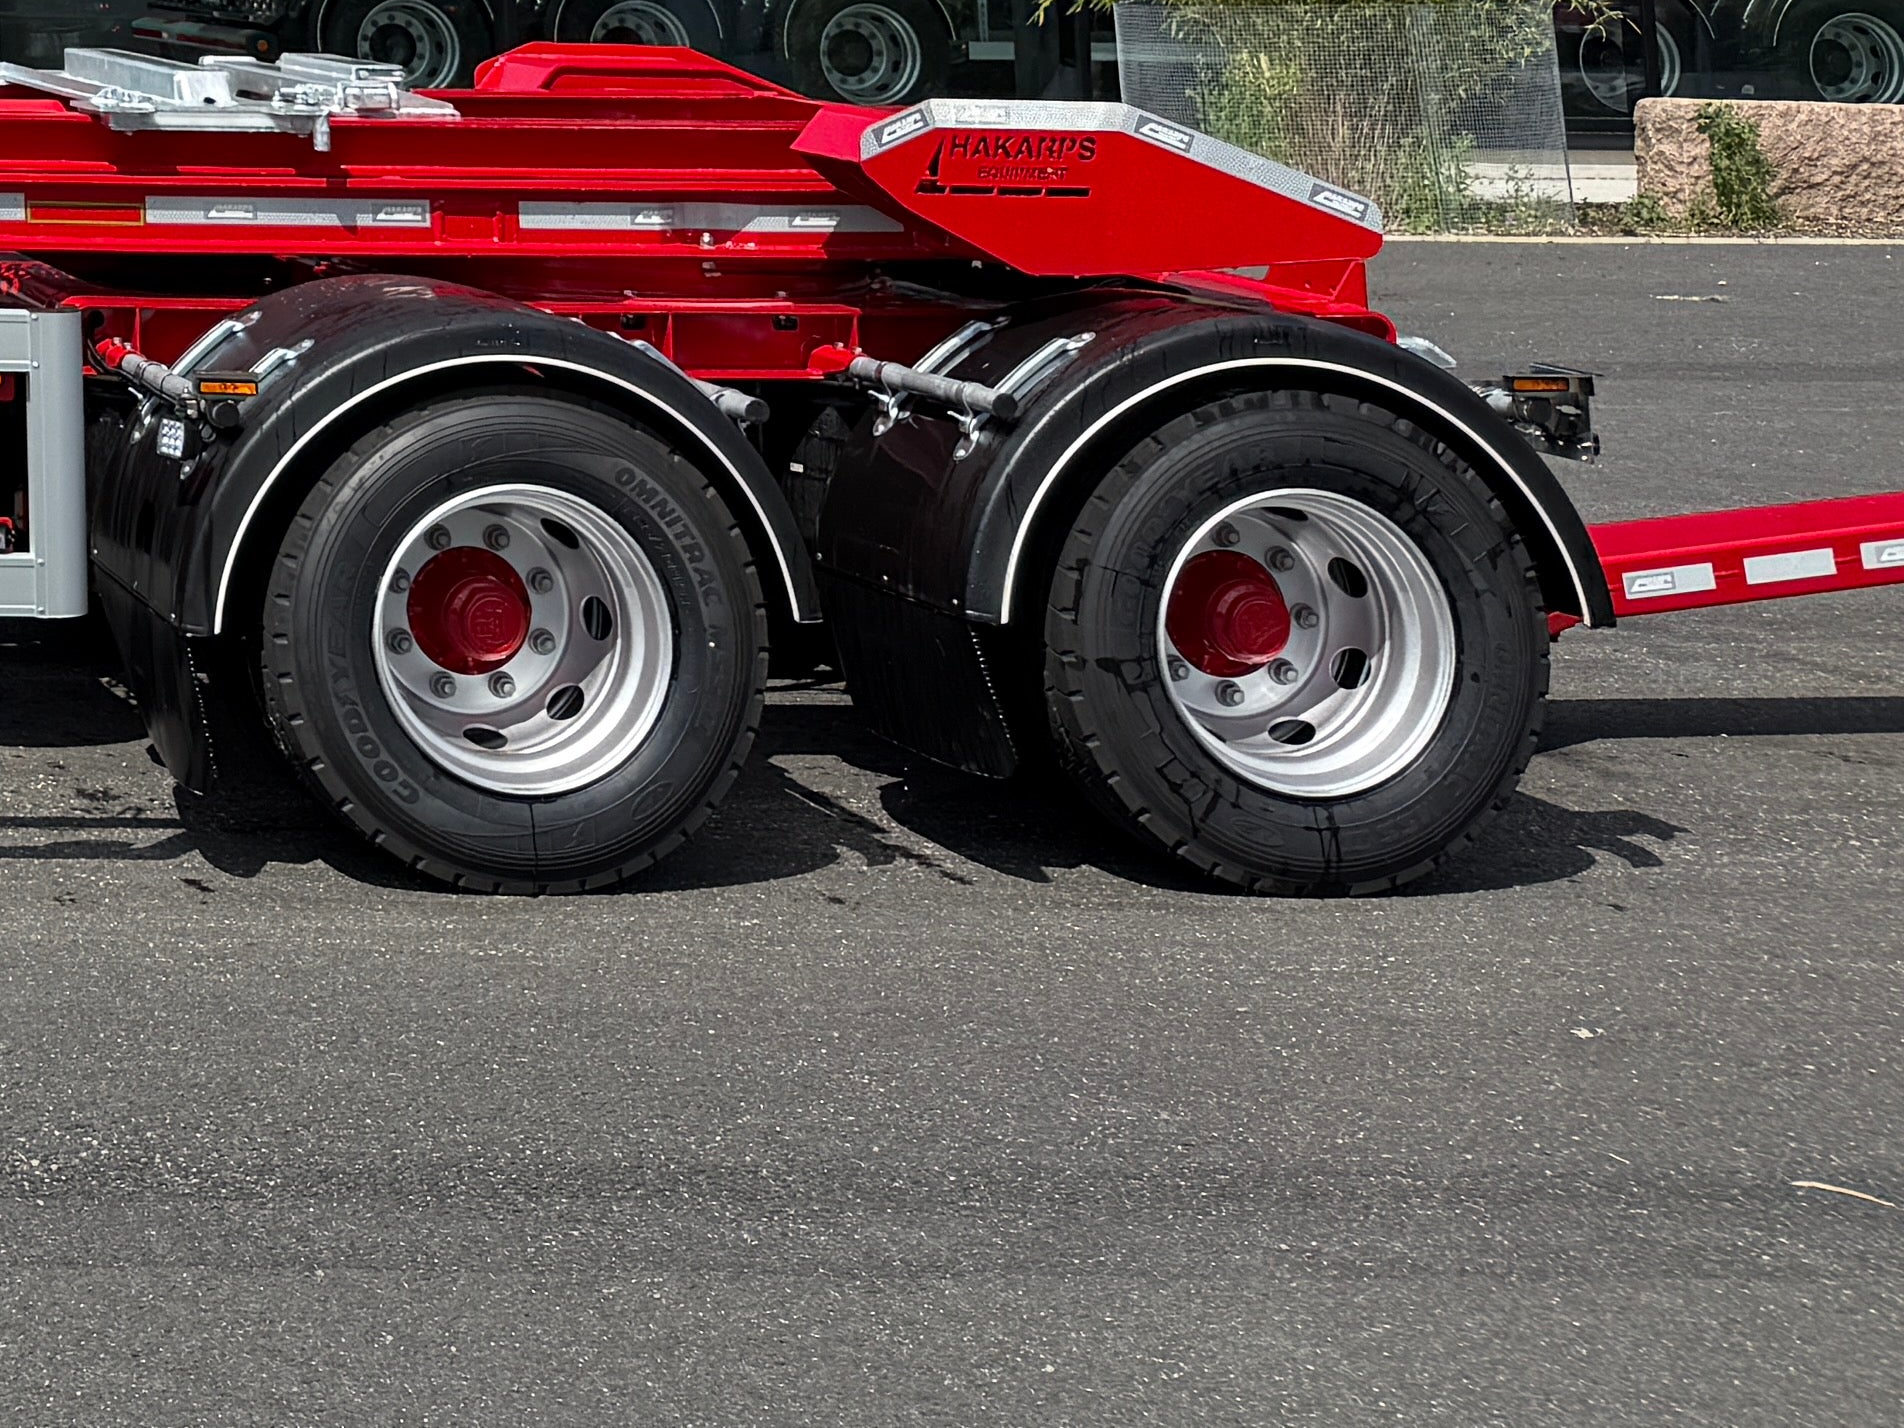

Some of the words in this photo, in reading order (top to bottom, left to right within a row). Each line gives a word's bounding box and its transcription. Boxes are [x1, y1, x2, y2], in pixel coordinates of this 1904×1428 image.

[949, 133, 1097, 162] HAKARPS
[610, 462, 723, 607] OMNITRAC
[320, 556, 426, 807] GOODYEAR
